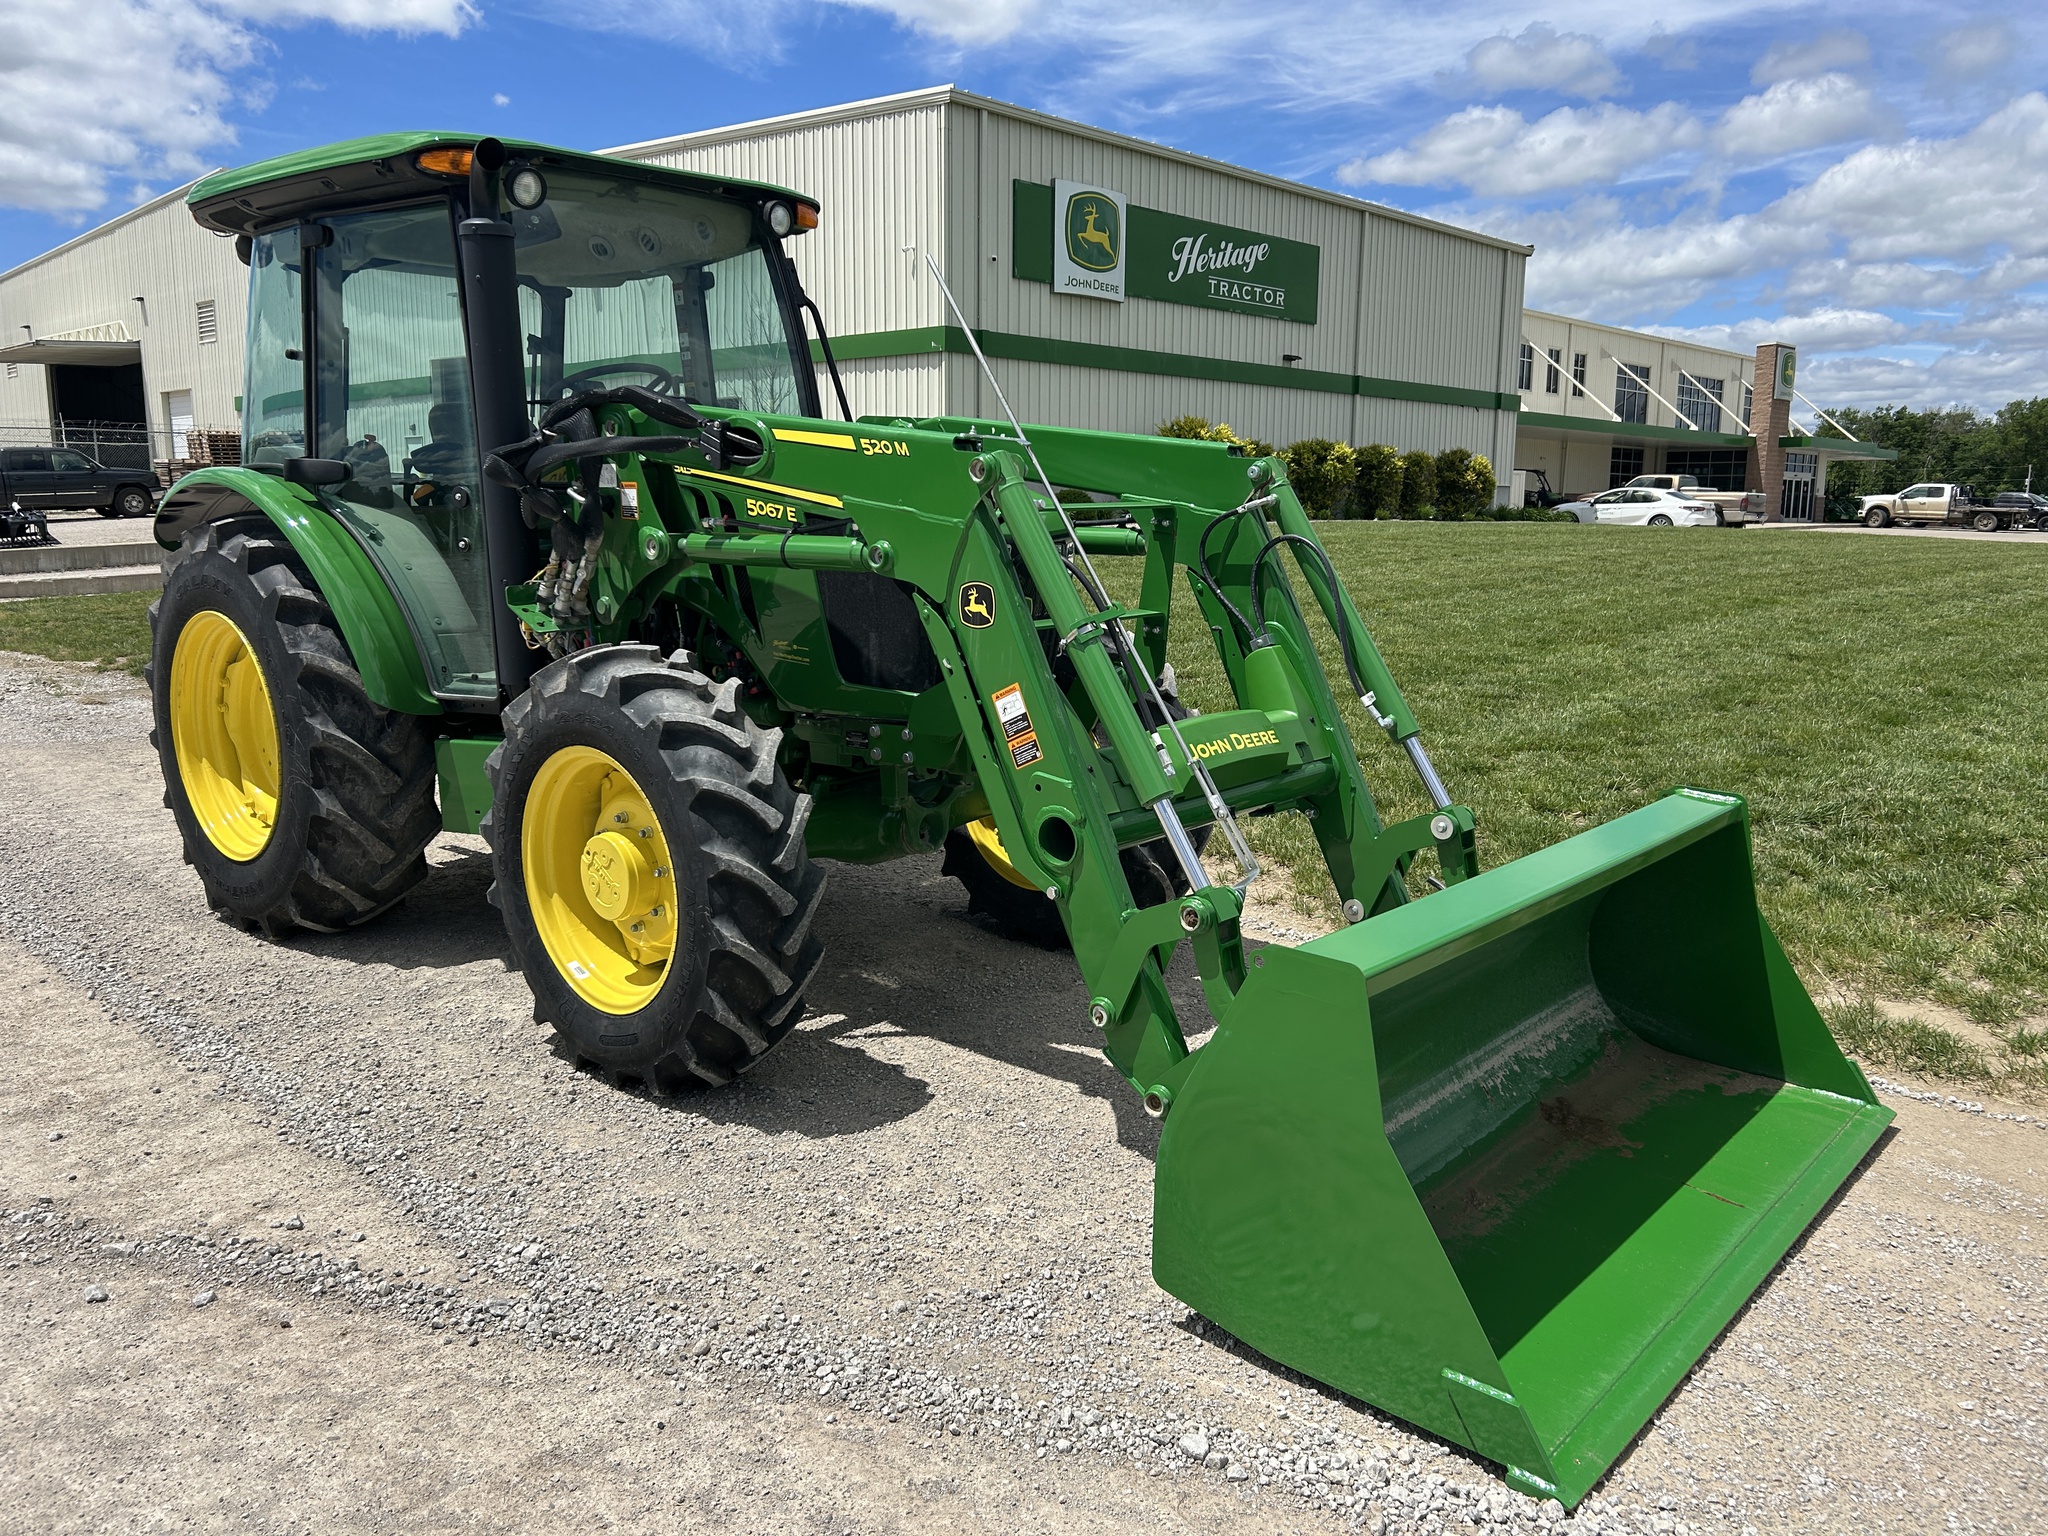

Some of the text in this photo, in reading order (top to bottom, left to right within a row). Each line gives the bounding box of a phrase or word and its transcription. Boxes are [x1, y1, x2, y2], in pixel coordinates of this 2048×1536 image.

[1168, 233, 1270, 283] Heritage
[1064, 275, 1120, 295] JOHN DEERE
[1208, 279, 1285, 306] TRACTOR
[859, 437, 911, 457] 520 M
[746, 498, 798, 523] 5067 E
[1189, 730, 1280, 761] JOHN DEERE
